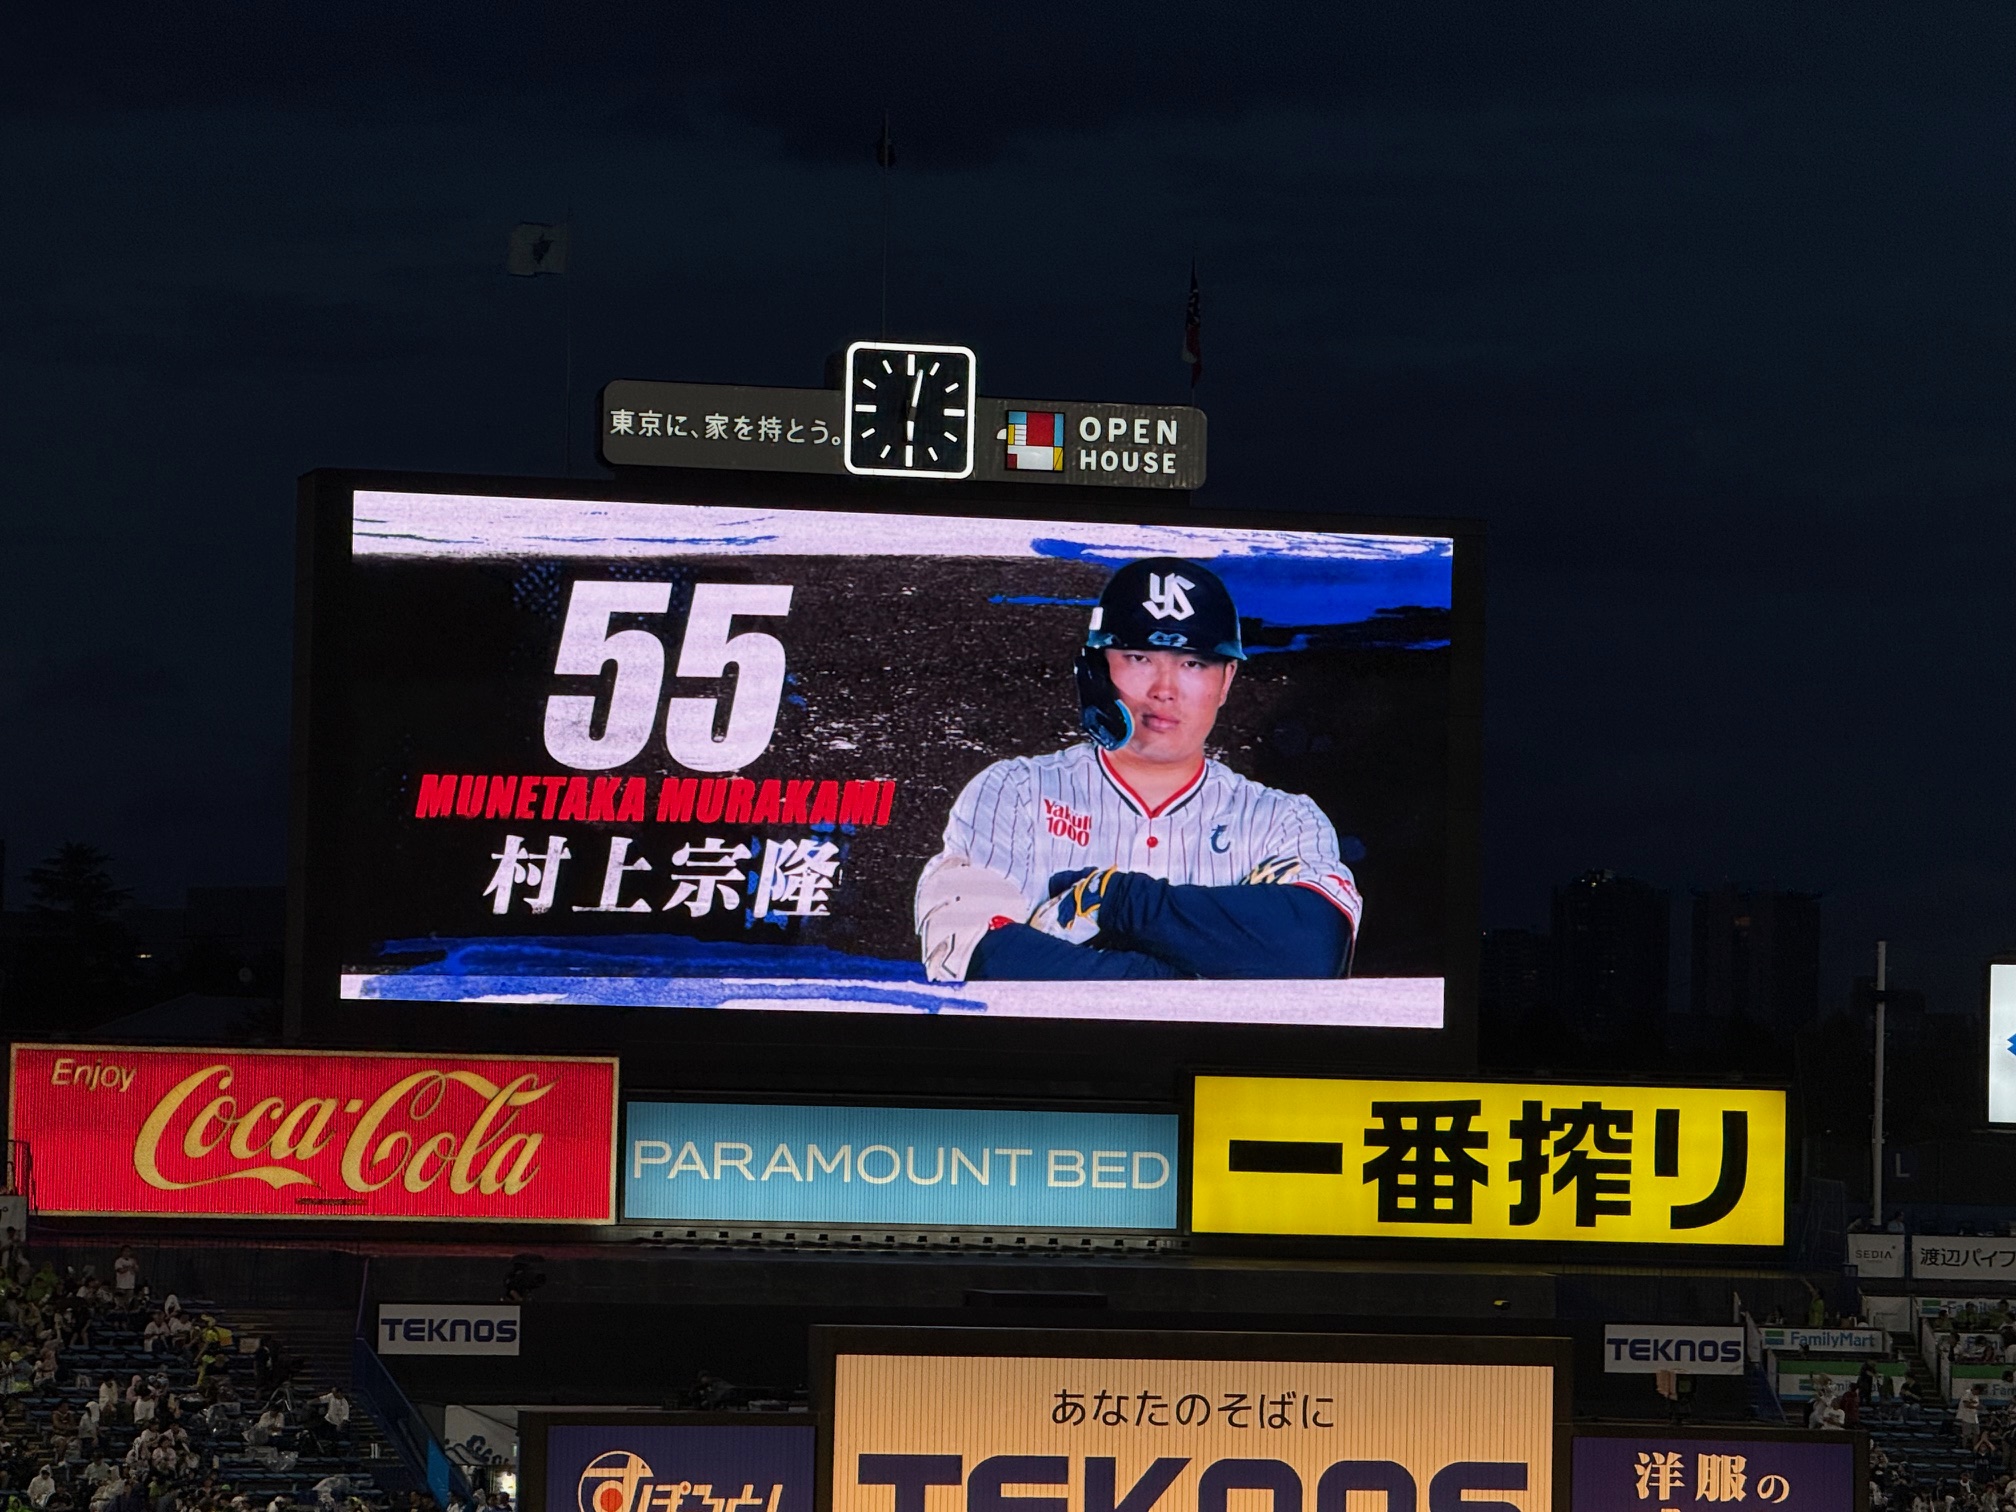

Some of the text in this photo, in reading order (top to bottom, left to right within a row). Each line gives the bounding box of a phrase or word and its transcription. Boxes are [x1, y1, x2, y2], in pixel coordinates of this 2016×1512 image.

[609, 408, 842, 447] 東京に、家を持とう。
[1079, 415, 1179, 446] OPEN
[1080, 450, 1178, 474] HOUSE
[543, 580, 794, 772] 55
[415, 773, 896, 826] MUNETAKA MURAKAMI
[483, 834, 842, 917] 村上宗隆
[51, 1058, 137, 1093] Enjoy
[133, 1064, 562, 1197] Coca-Cola
[633, 1140, 1170, 1190] PARAMOUNT BED
[1229, 1099, 1749, 1229] 一番搾り
[381, 1318, 517, 1343] TEKNOS
[1606, 1337, 1741, 1363] TEKNOS
[1790, 1331, 1875, 1349] FamilyMart
[1051, 1388, 1334, 1429] あなたのそばに
[1634, 1451, 1790, 1504] 洋服の
